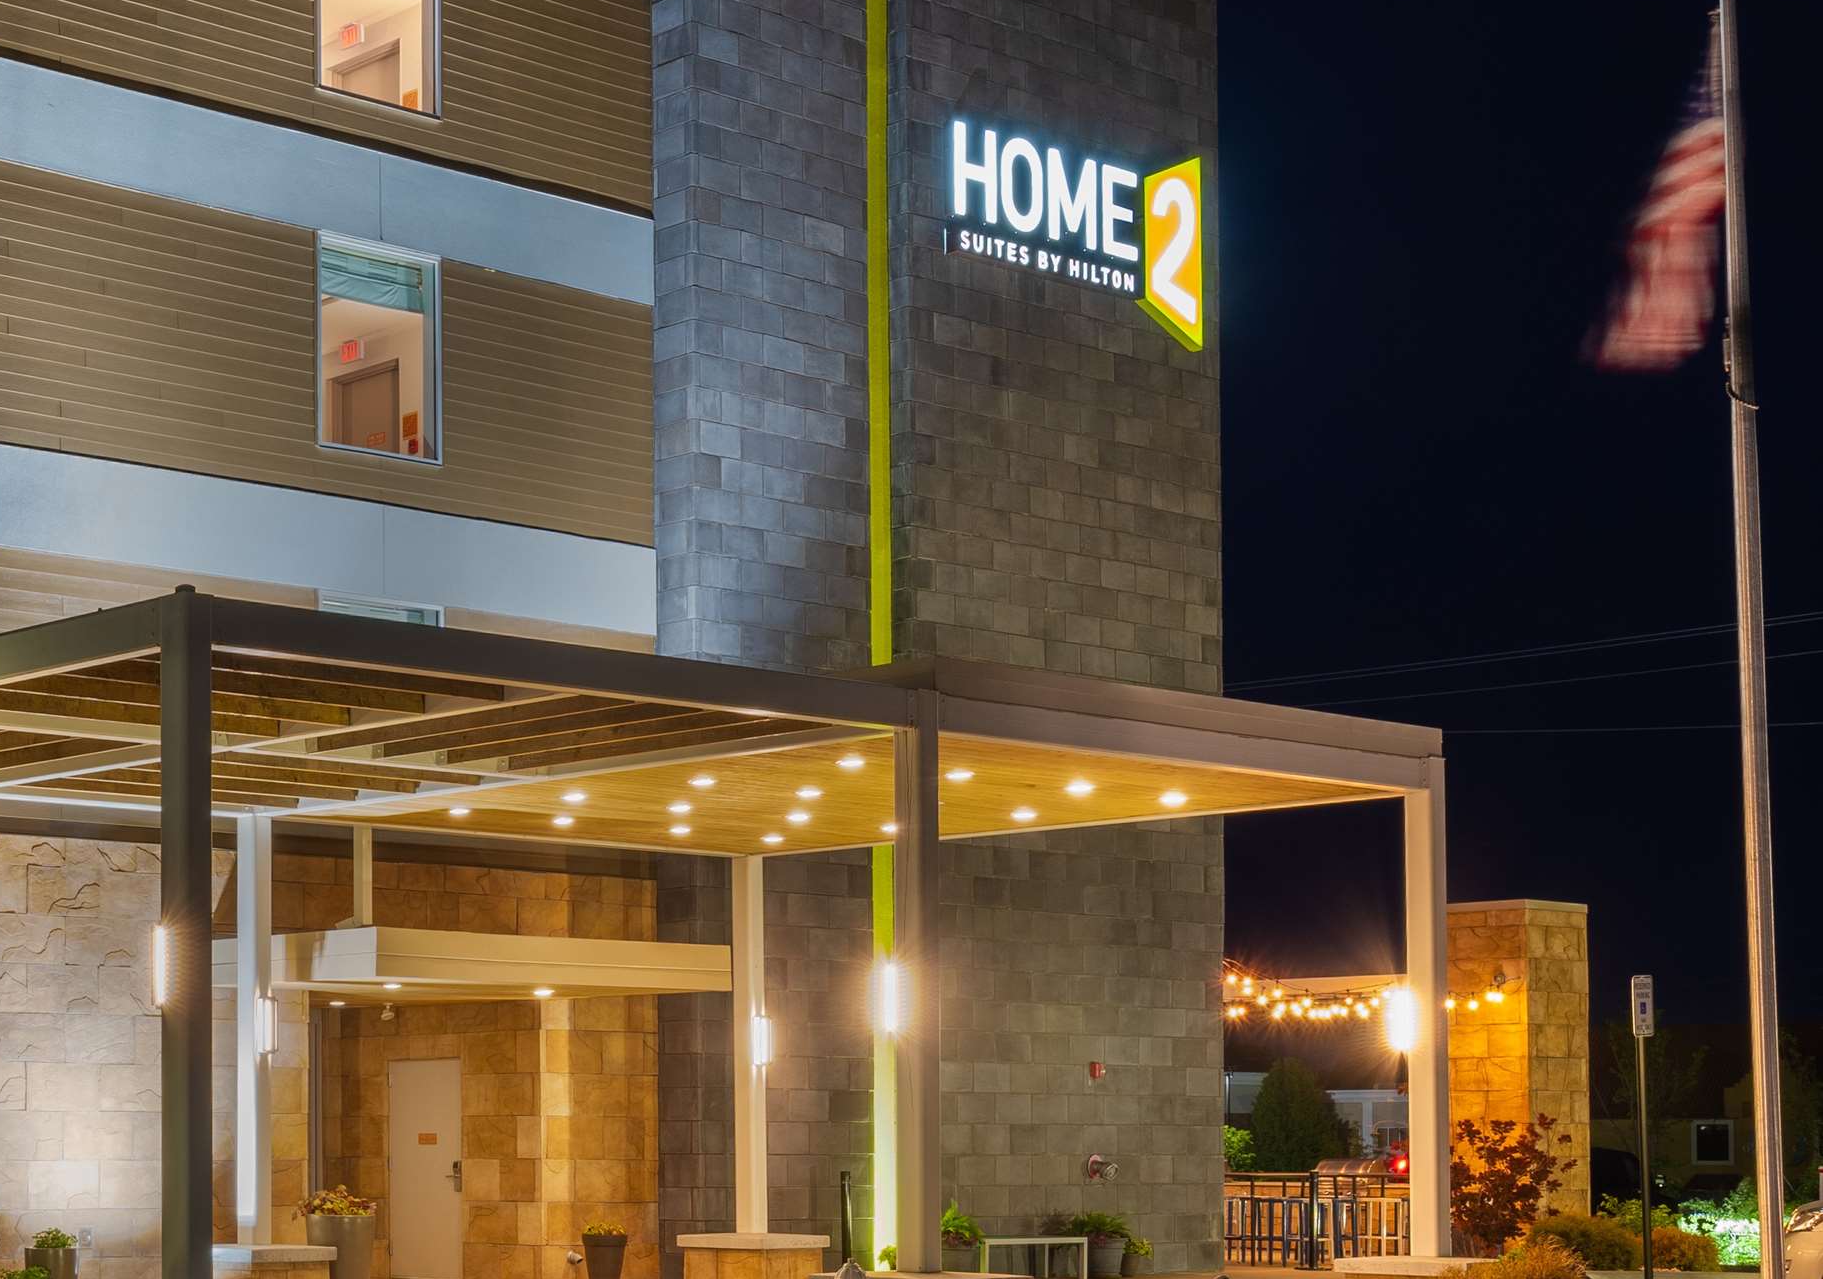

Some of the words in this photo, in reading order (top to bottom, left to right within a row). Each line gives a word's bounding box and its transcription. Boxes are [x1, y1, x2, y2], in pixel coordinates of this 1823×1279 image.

[953, 120, 1139, 262] HOME
[1151, 177, 1197, 325] 2
[959, 229, 1029, 266] SUITES
[1037, 250, 1061, 273] BY
[1069, 257, 1135, 293] HILTON
